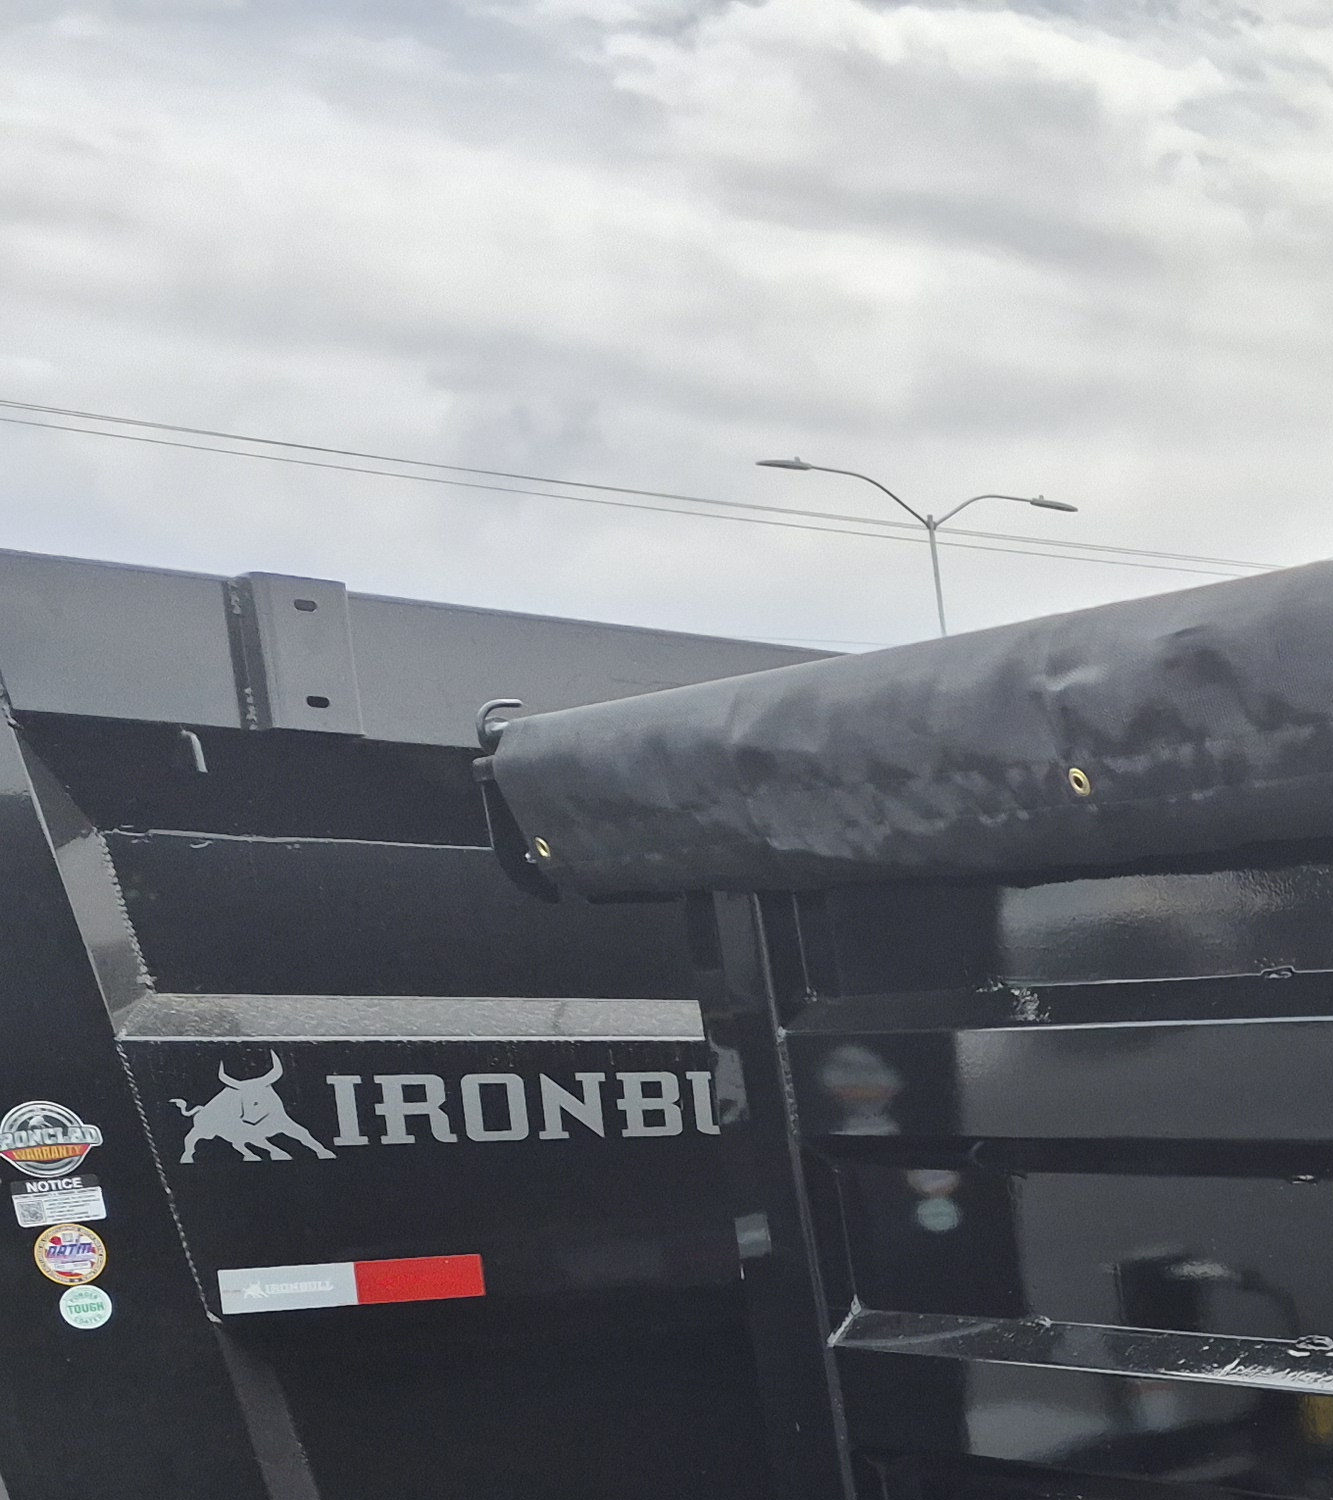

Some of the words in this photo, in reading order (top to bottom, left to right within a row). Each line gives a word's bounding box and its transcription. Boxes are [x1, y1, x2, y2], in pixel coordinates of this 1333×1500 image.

[0, 1127, 98, 1152] RONCLAD
[12, 1145, 82, 1161] WARRANTY
[25, 1177, 83, 1193] NOTICE
[265, 1279, 334, 1295] IRONBULL
[67, 1301, 105, 1315] TOUGH
